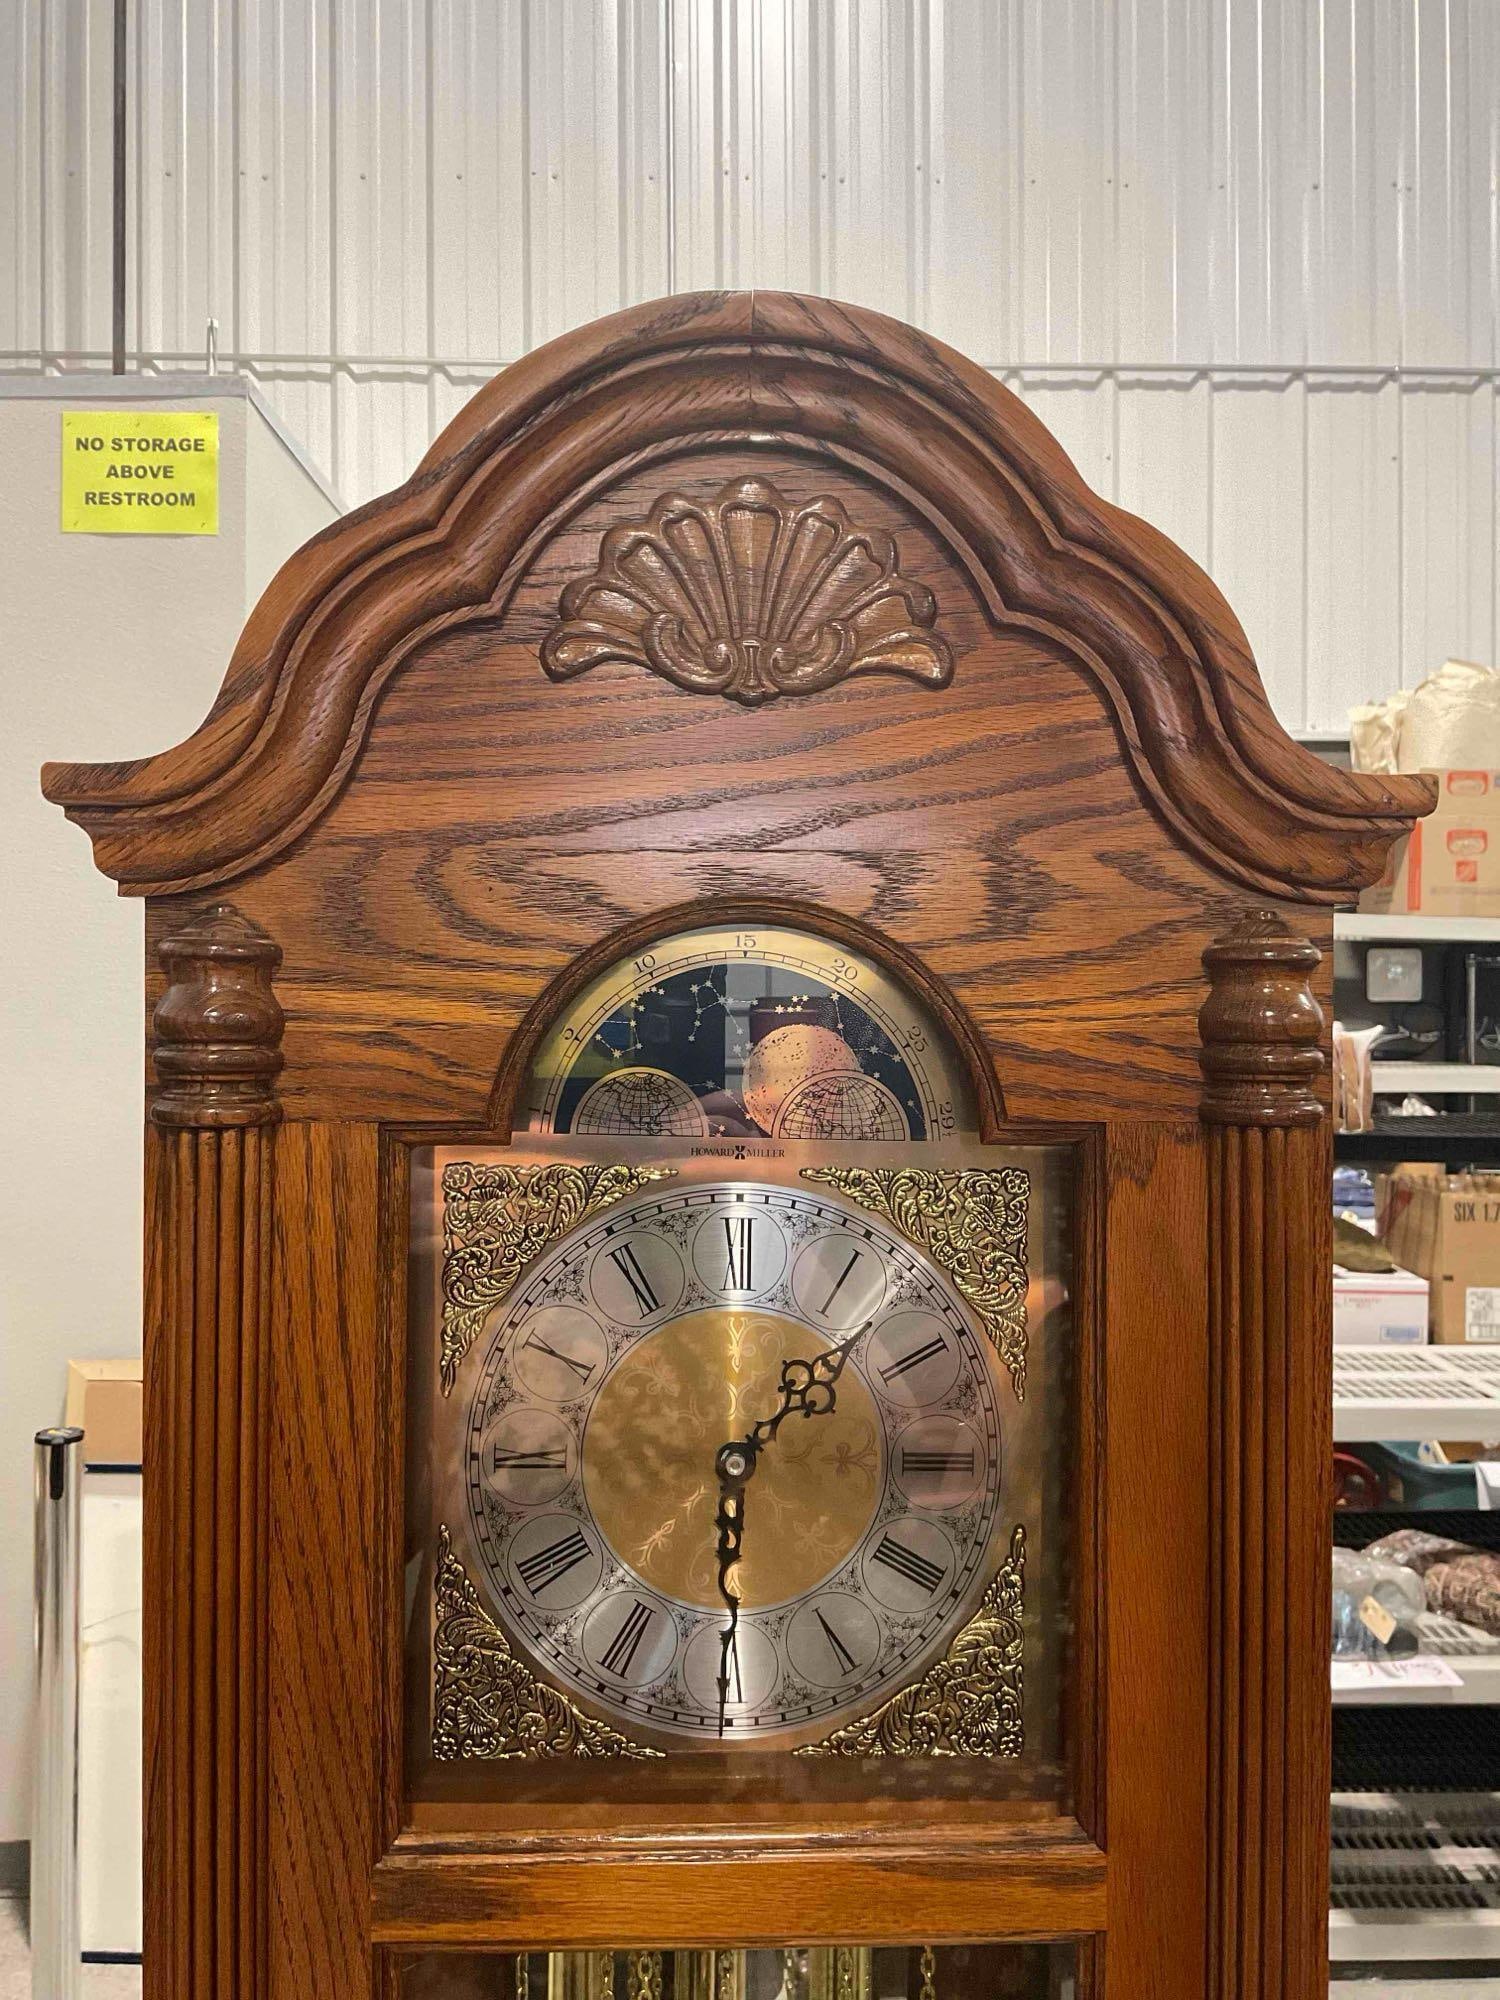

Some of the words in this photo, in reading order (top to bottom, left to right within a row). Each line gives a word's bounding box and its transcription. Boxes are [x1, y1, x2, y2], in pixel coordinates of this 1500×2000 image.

[75, 437, 104, 451] NO
[111, 437, 205, 452] STORAGE
[106, 464, 175, 479] ABOVE
[84, 491, 195, 506] RESTROOM
[735, 934, 757, 948] 15
[633, 954, 656, 974] 10
[833, 958, 859, 981] 20
[906, 1025, 929, 1052] 25
[690, 1146, 735, 1157] HOWARD
[746, 1148, 786, 1158] MILLER
[1453, 1202, 1476, 1222] SIX
[719, 1216, 756, 1292] XII
[605, 1240, 665, 1320] XI
[815, 1248, 864, 1319] I
[521, 1328, 597, 1384] X
[879, 1332, 950, 1388] II
[493, 1443, 568, 1473] IX
[900, 1447, 975, 1478] III
[514, 1525, 594, 1600] VIII
[595, 1598, 657, 1680] VII
